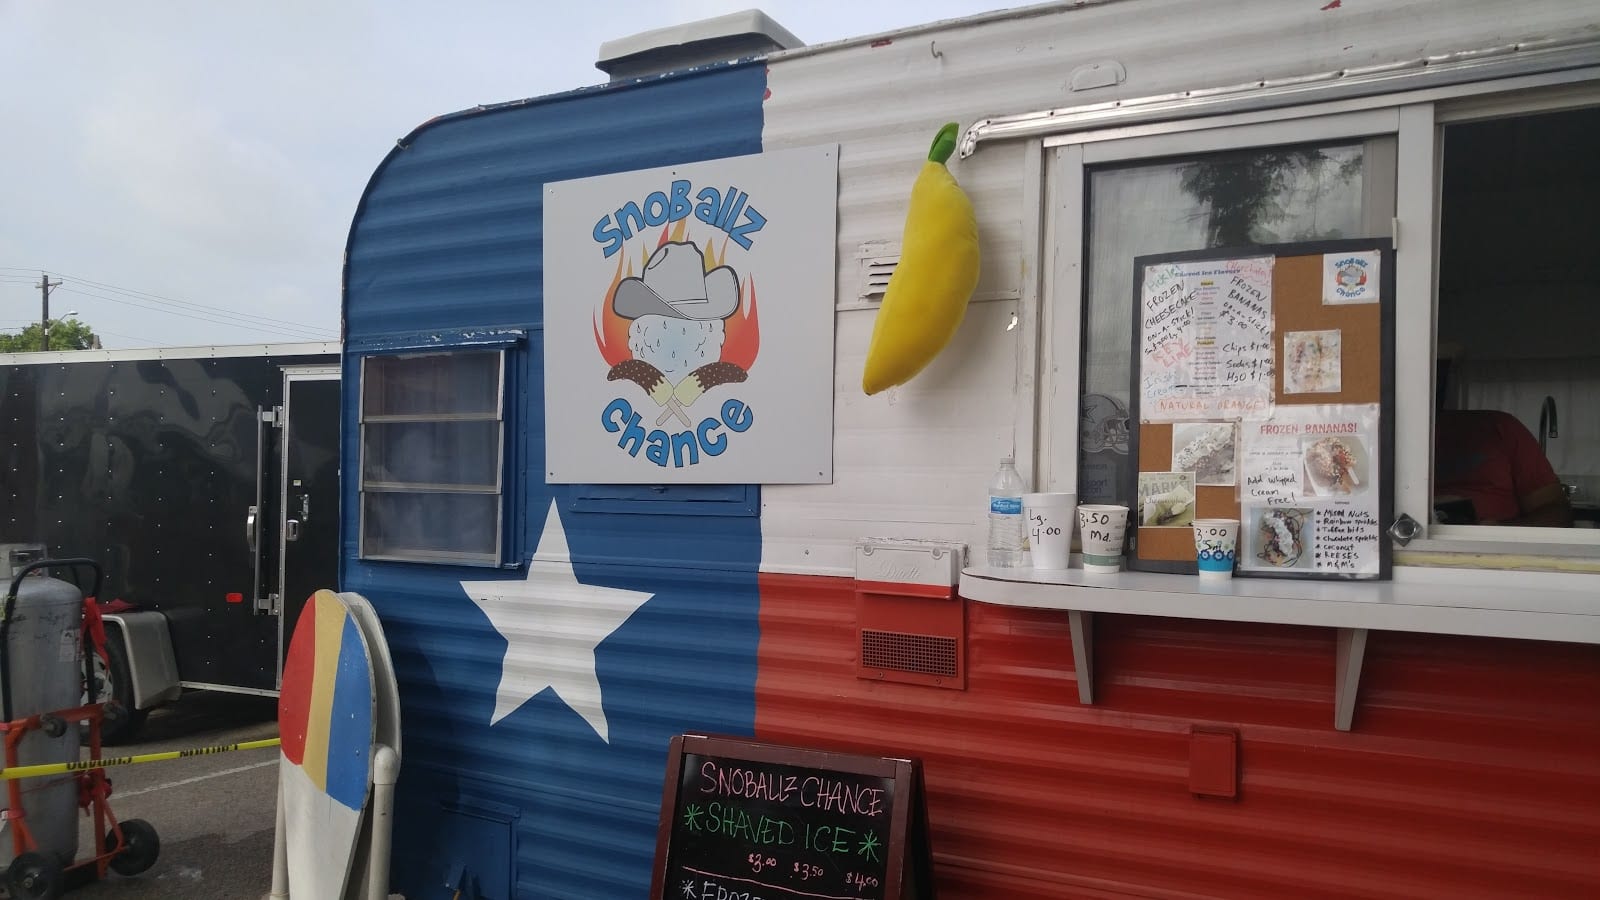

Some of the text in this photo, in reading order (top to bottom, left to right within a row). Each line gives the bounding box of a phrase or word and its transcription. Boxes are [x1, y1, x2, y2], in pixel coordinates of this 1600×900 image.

[1146, 279, 1184, 312] FROZEN
[1231, 276, 1268, 301] FROZEN
[1145, 289, 1198, 329] CHEESECAKE
[1228, 289, 1267, 320] BANANAS
[1222, 341, 1247, 357] Chips
[1160, 400, 1210, 410] NATURAL
[601, 398, 754, 468] Chance
[1260, 422, 1358, 435] FROZEN BANANAS!
[1080, 512, 1110, 529] 3.50
[1196, 527, 1227, 542] 3.00
[1032, 527, 1061, 545] 4.00
[701, 761, 885, 817] SNOBALLZ CHANCE
[705, 802, 857, 852] SHAVED ICE
[748, 853, 879, 890] $3.00 $3.50 $4.00
